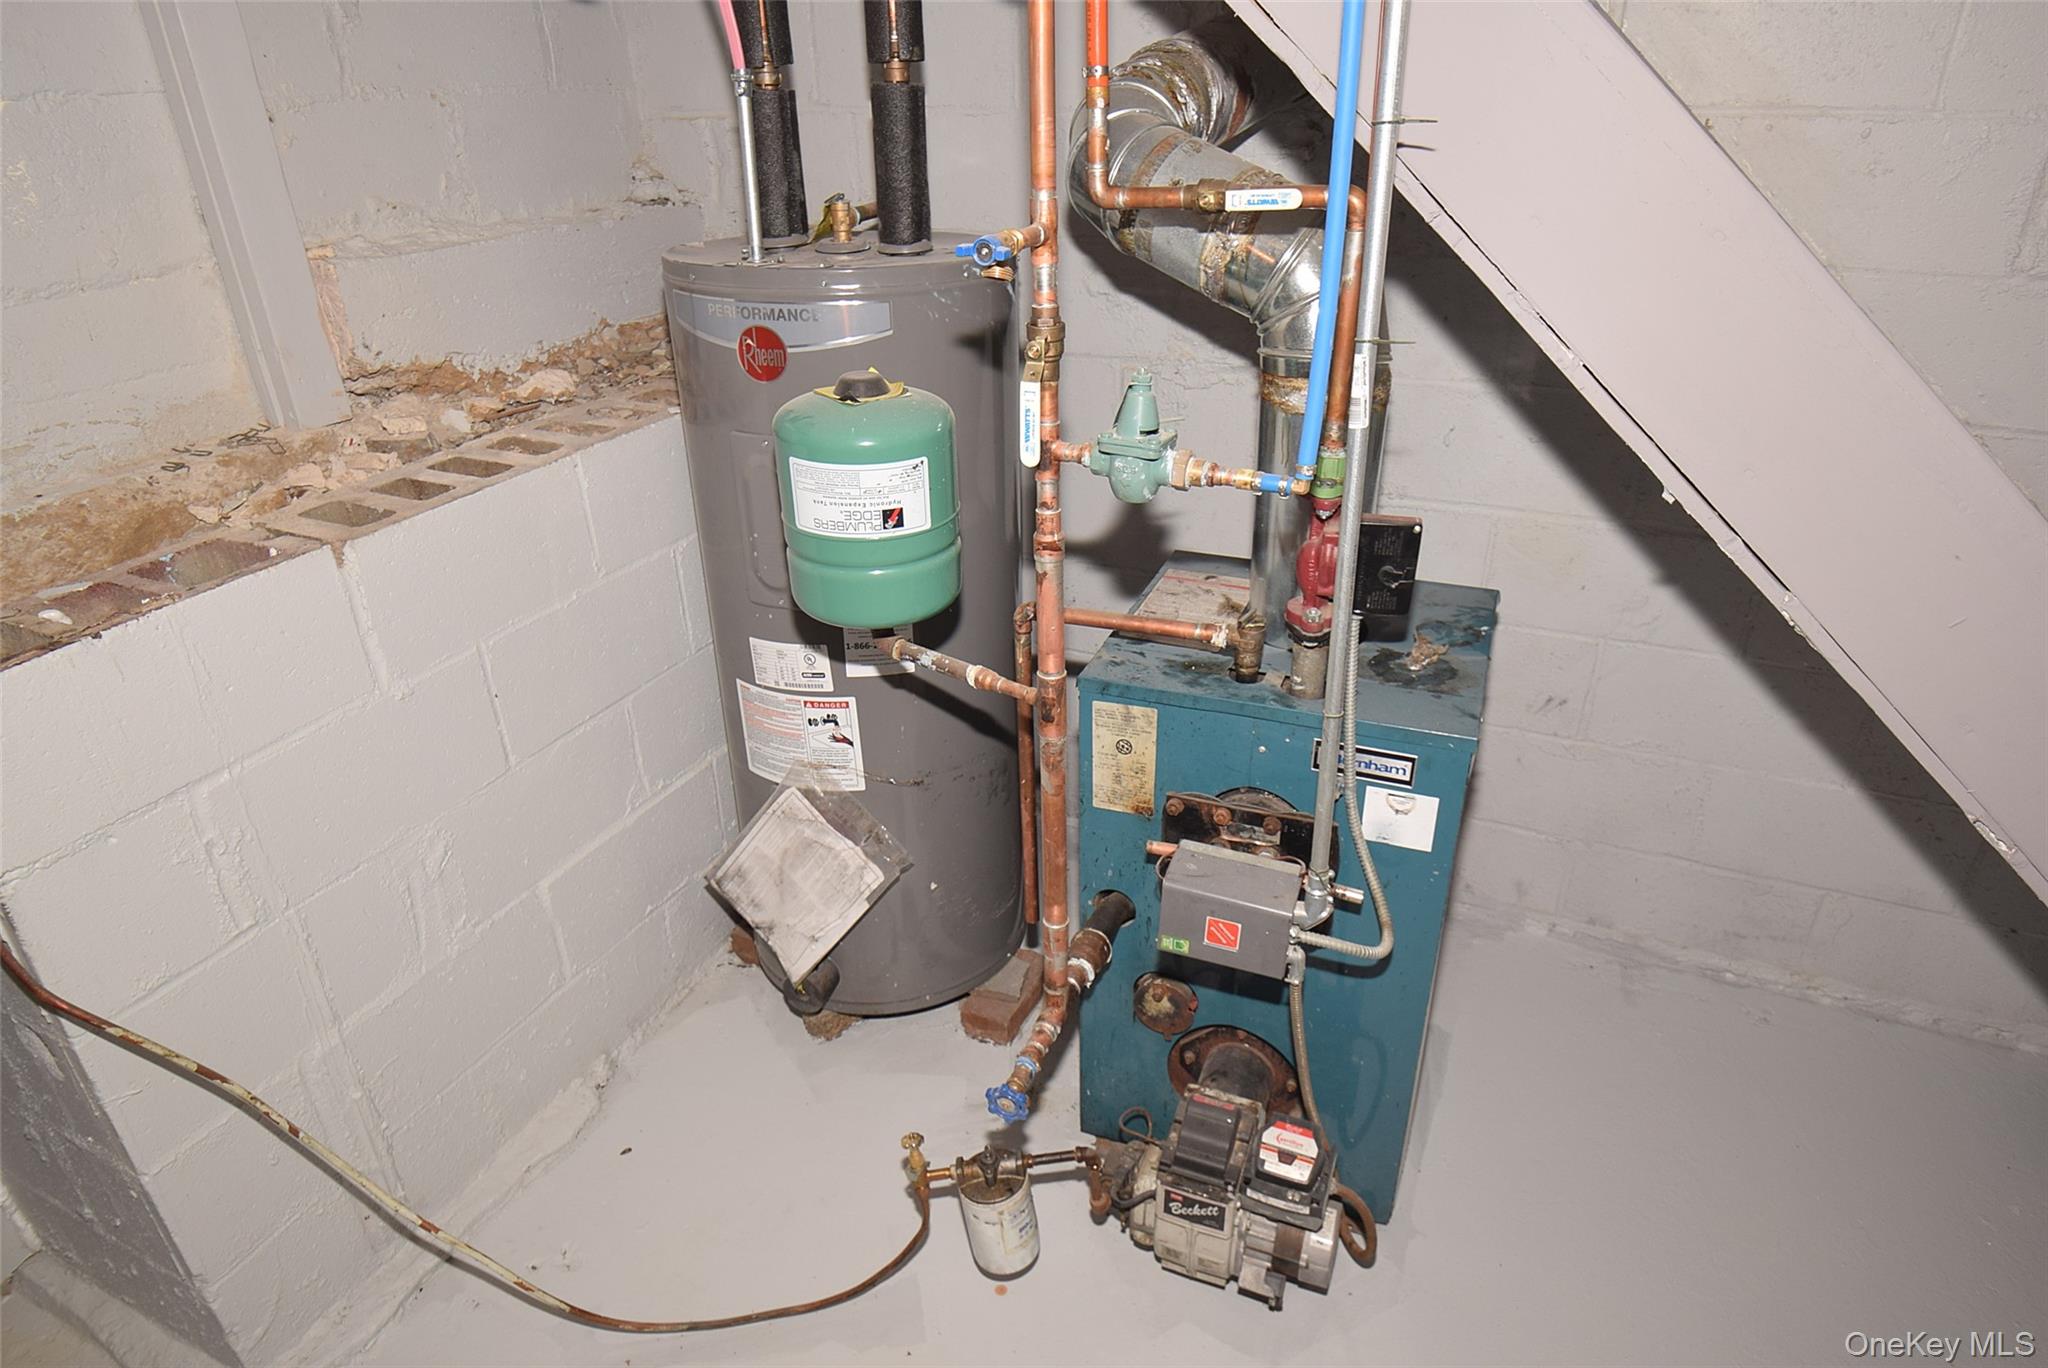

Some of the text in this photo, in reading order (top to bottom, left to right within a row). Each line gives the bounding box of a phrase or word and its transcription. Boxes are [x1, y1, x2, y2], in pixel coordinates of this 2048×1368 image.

[707, 303, 820, 322] PERFORMANCE
[741, 328, 785, 373] Rheem
[869, 499, 902, 508] Hydronic
[842, 509, 882, 520] EDGE
[813, 518, 882, 532] PLUMBERS
[813, 701, 848, 709] DANGER
[1168, 1201, 1220, 1217] Beckett
